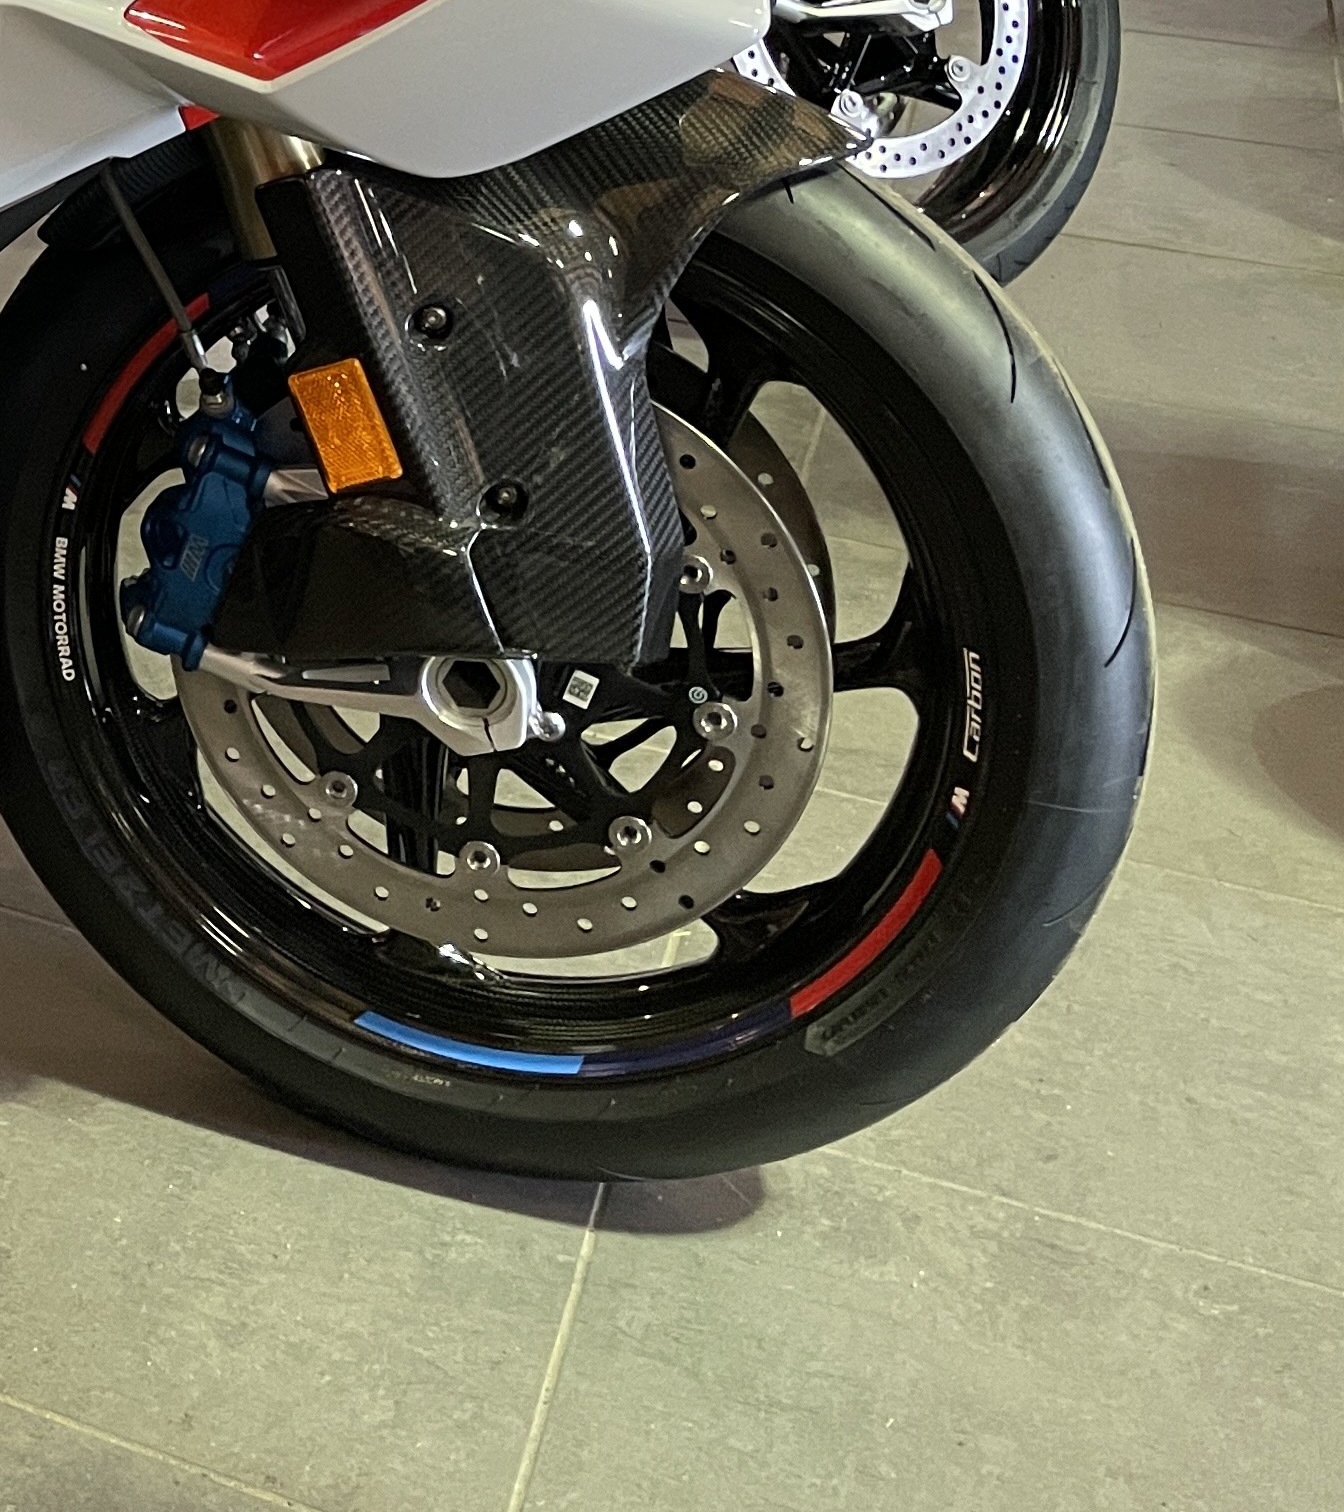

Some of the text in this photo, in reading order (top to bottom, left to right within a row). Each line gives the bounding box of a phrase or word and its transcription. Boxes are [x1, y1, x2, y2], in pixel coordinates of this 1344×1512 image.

[52, 537, 76, 682] BMW MOTORRAD
[963, 647, 983, 763] Carbon
